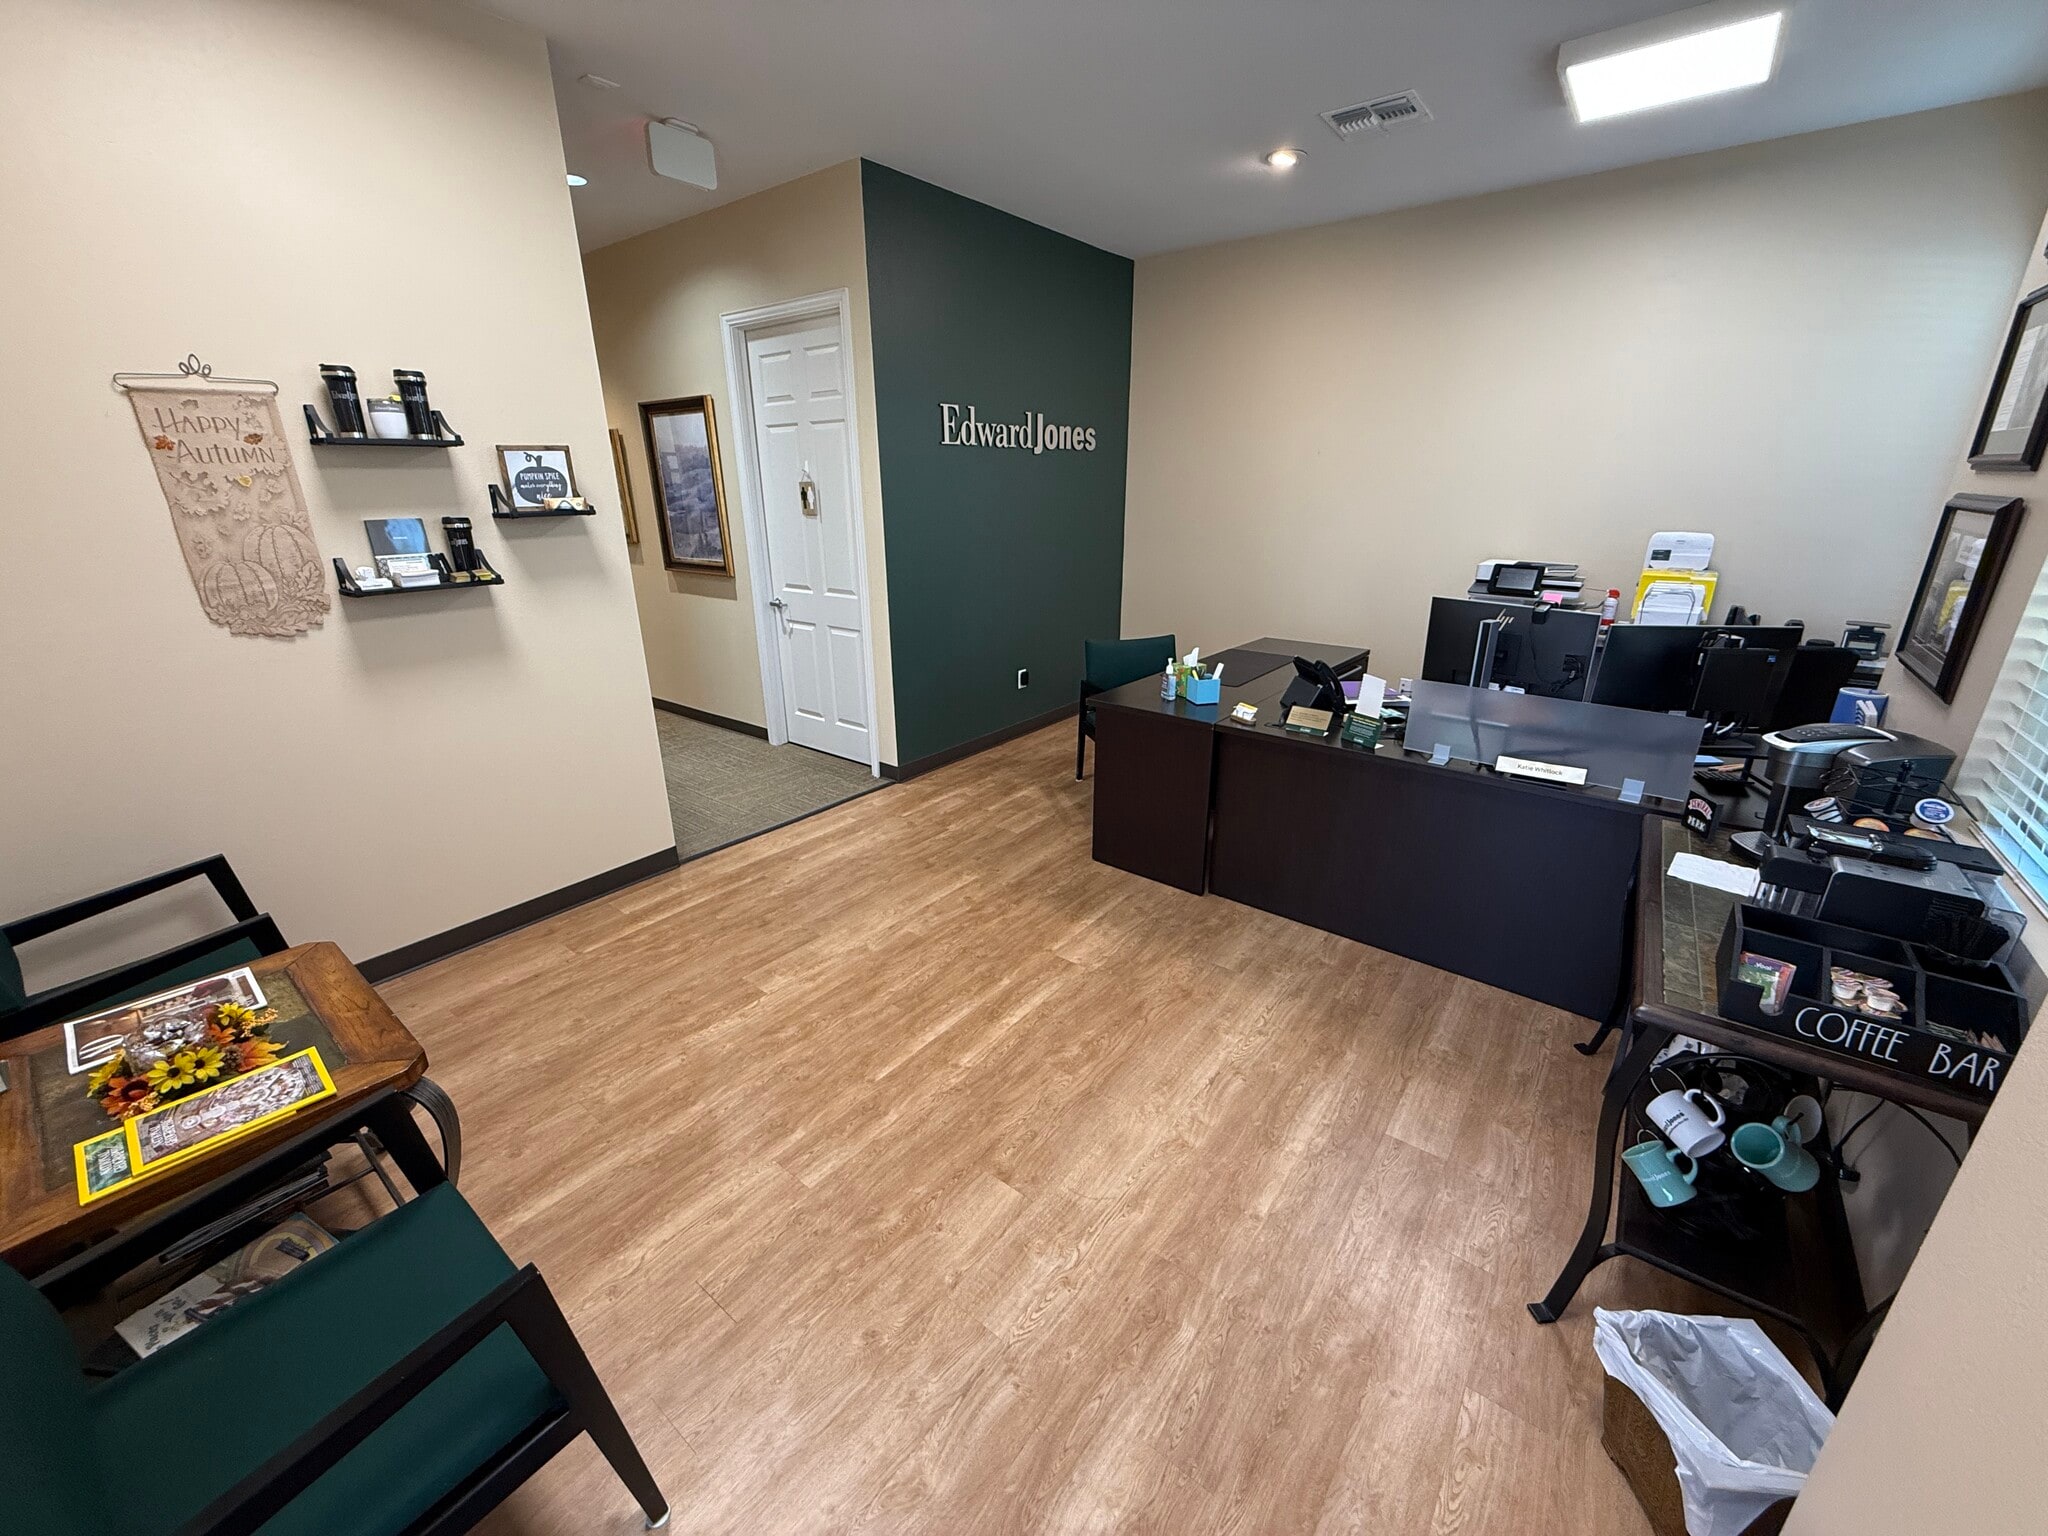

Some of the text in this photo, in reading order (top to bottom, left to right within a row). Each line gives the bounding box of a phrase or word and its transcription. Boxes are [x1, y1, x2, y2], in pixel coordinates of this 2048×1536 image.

[152, 407, 240, 441] HAPPY
[519, 472, 560, 481] PUMPKIN SPICE
[536, 481, 562, 492] everything
[1517, 763, 1534, 771] Katie
[1795, 1007, 2000, 1092] COFFEE BAR
